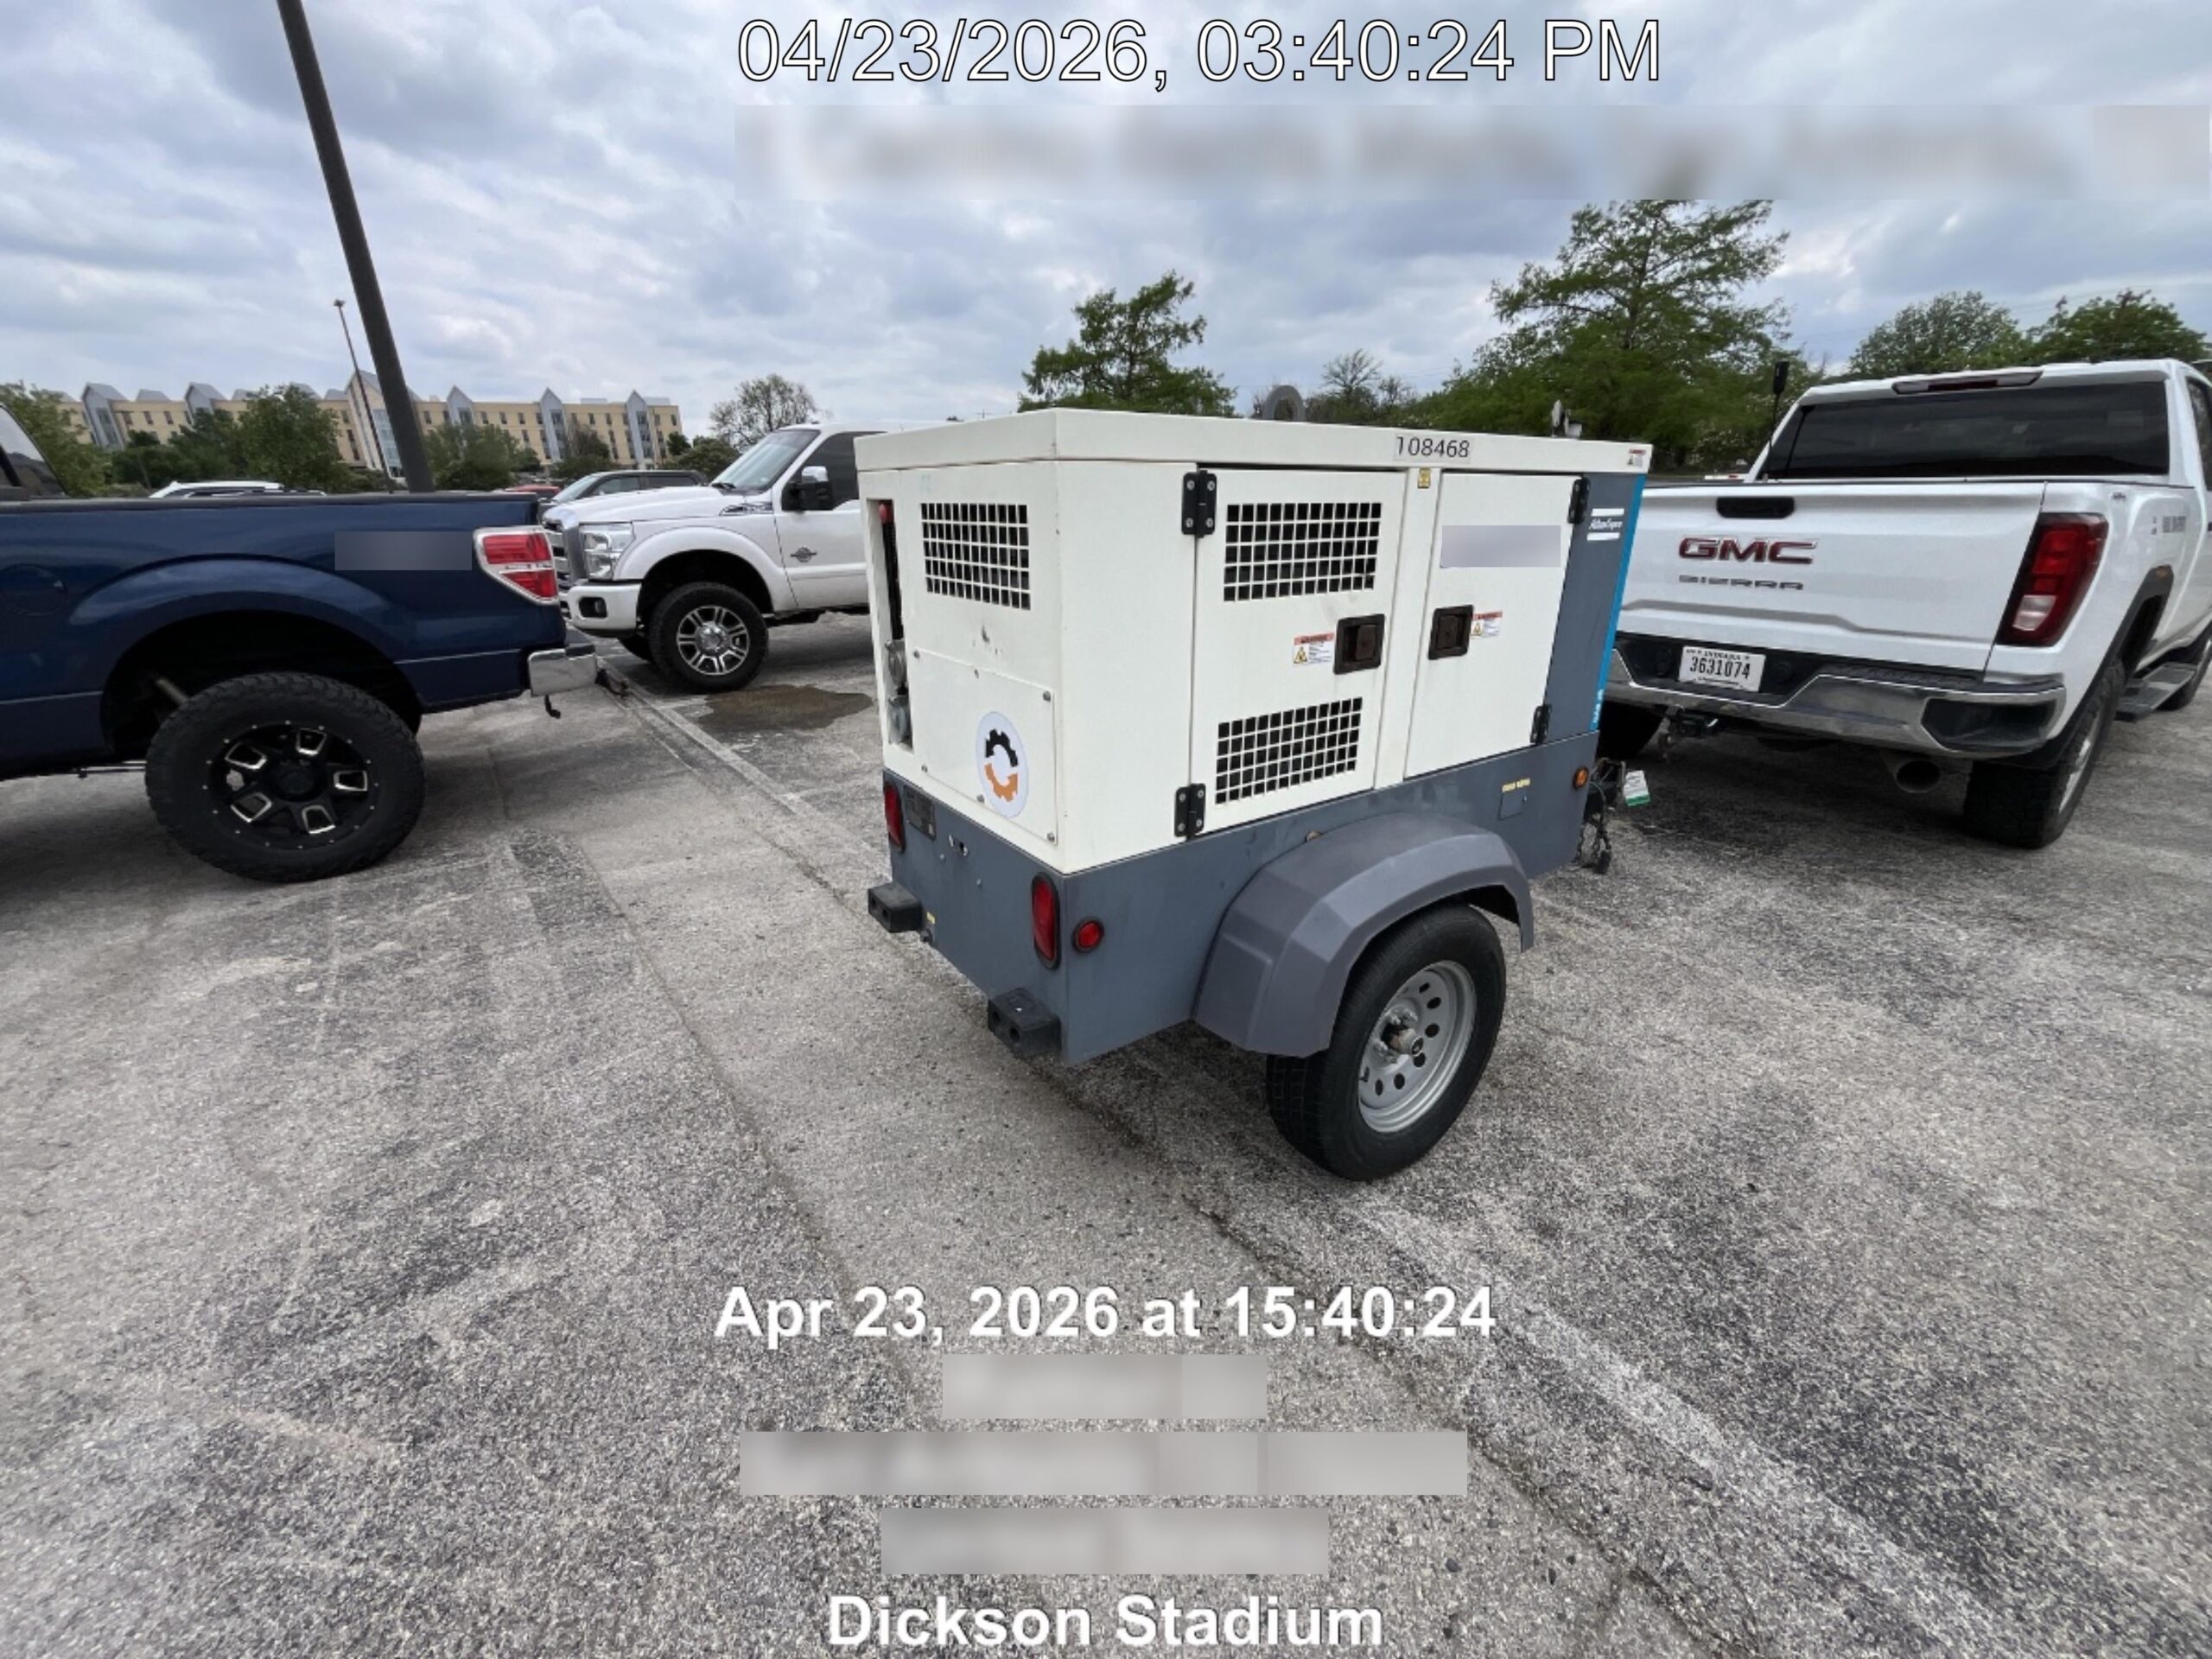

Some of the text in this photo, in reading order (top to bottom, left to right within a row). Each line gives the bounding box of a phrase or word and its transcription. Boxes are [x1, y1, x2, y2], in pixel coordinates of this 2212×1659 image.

[1396, 435, 1470, 458] 108468
[1678, 536, 1816, 565] GMC
[1689, 657, 1751, 680] 3631074
